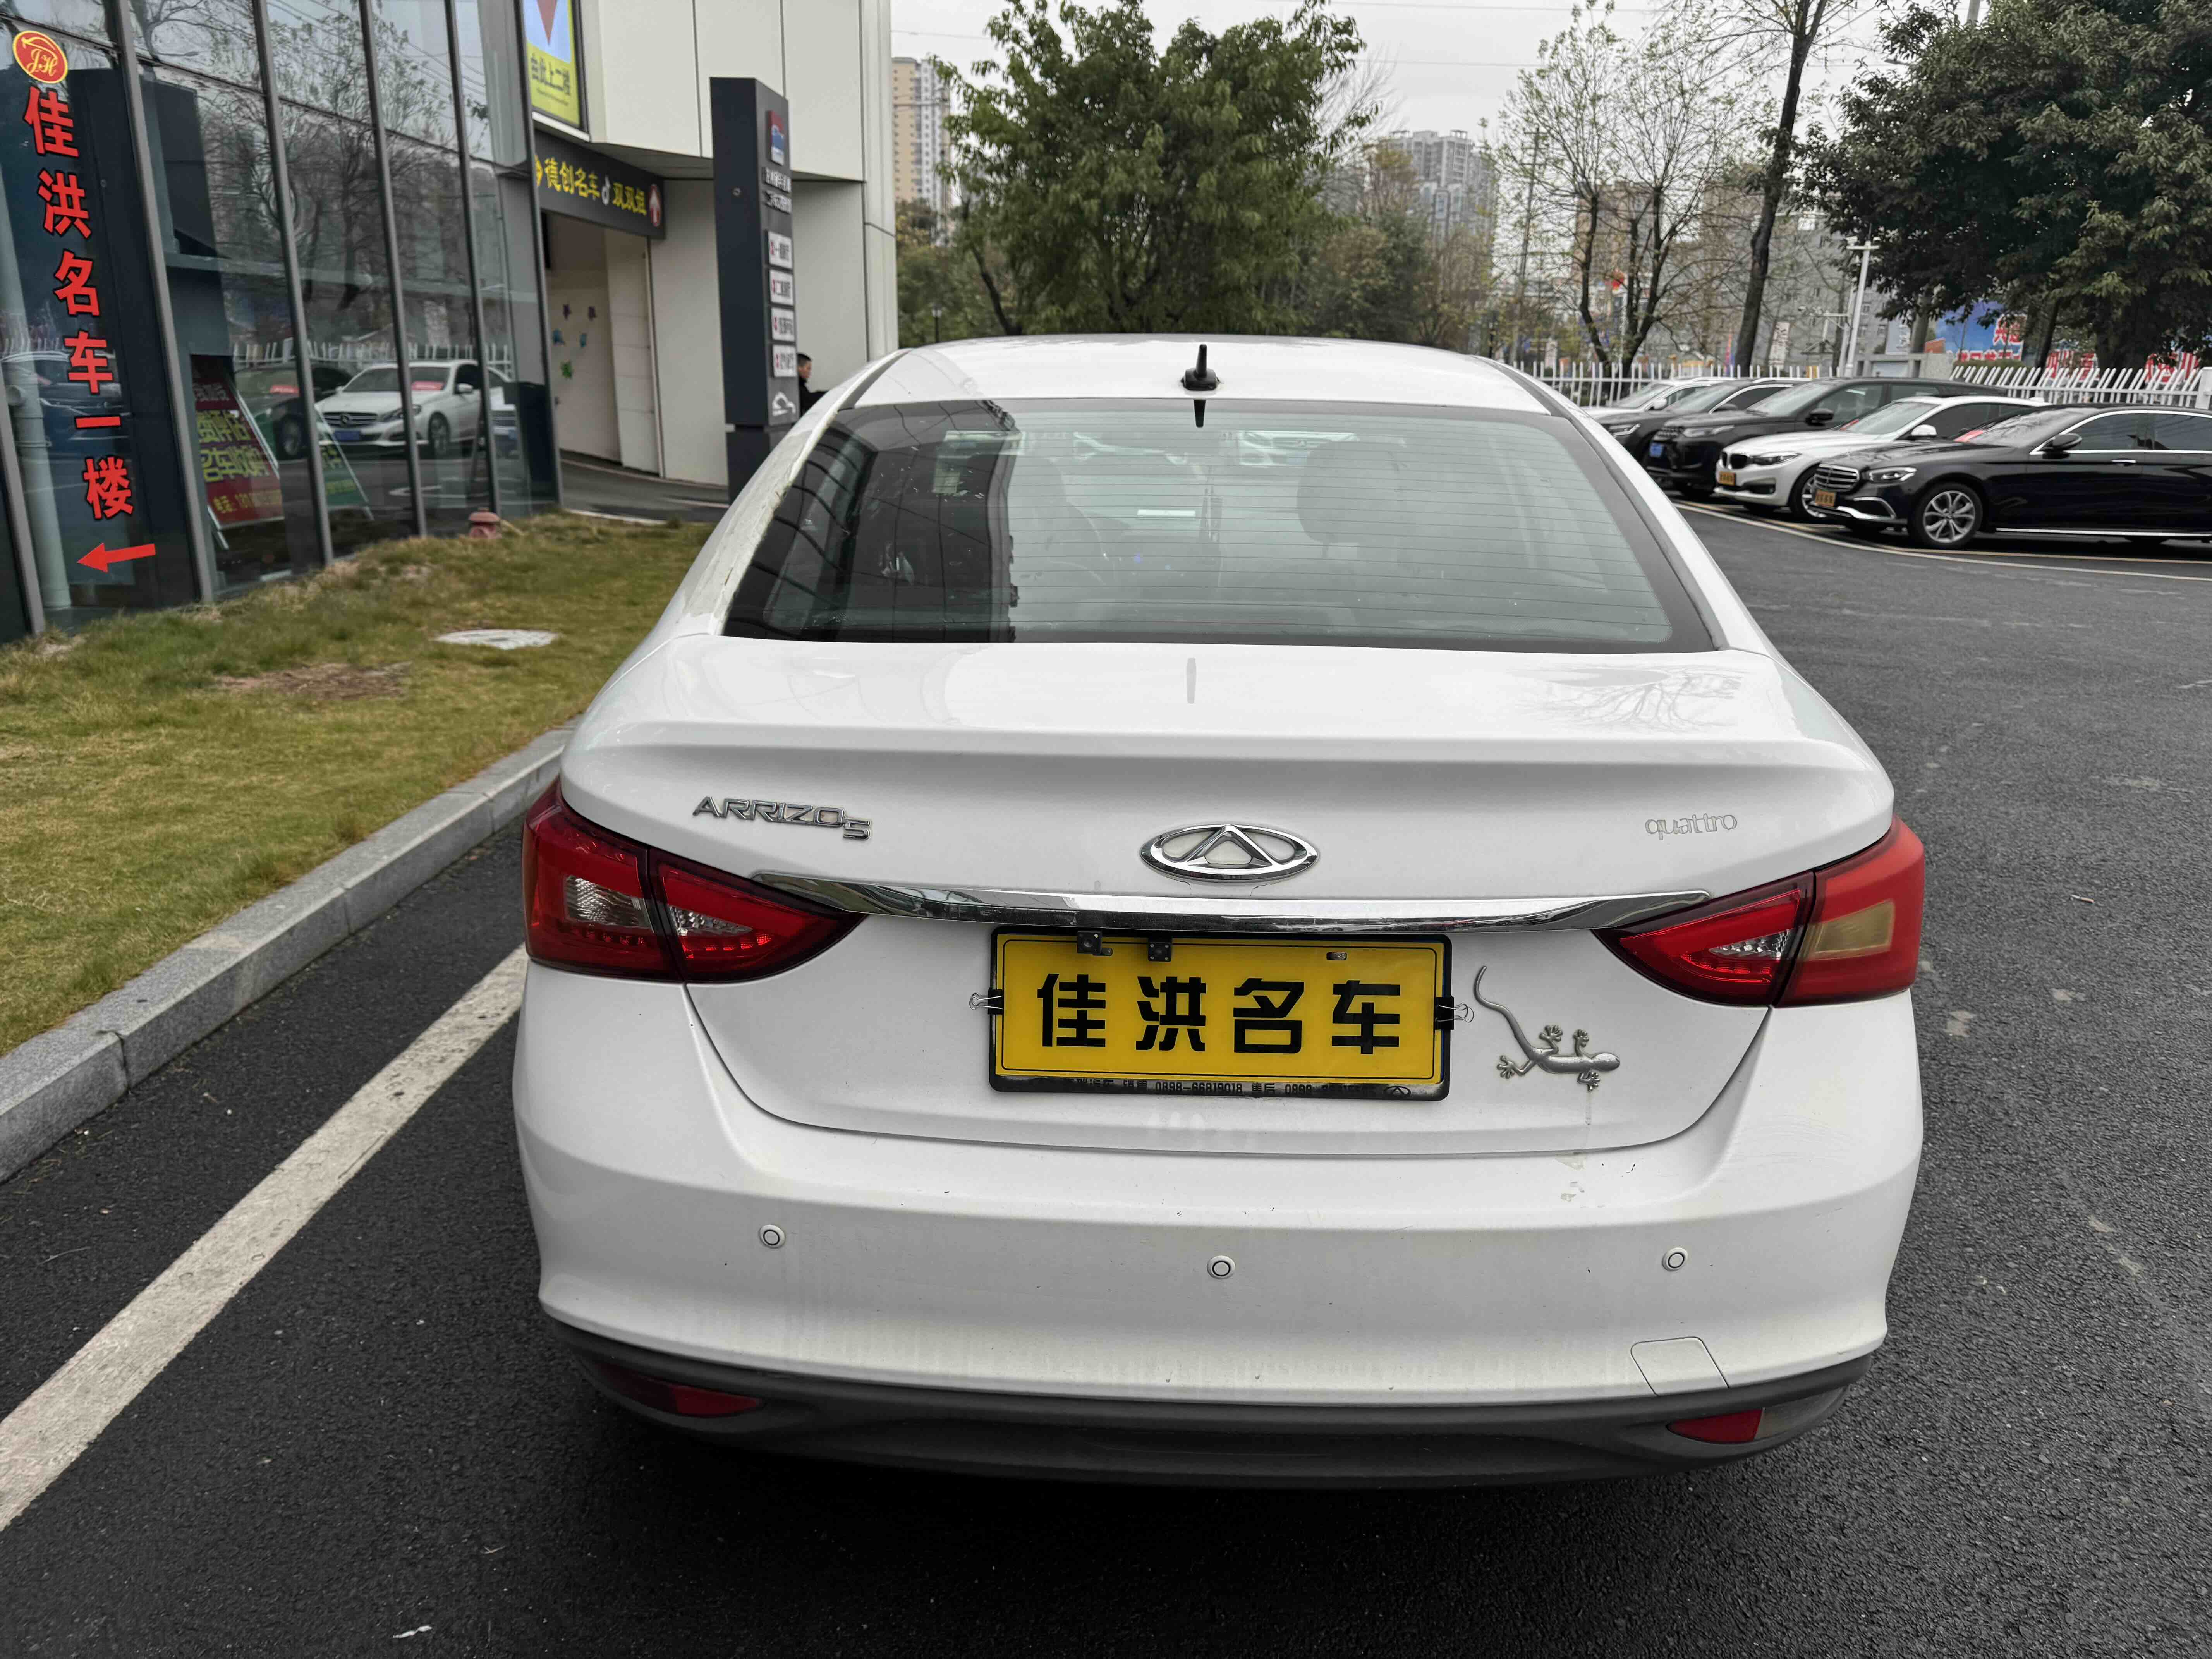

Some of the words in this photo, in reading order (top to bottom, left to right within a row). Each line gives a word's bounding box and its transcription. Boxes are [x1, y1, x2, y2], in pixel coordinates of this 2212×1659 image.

[24, 86, 134, 519] 佳洪名车一楼
[1645, 813, 1738, 840] quattro
[1037, 973, 1401, 1055] 佳洪名车
[1155, 1080, 1243, 1094] 0898-66819018
